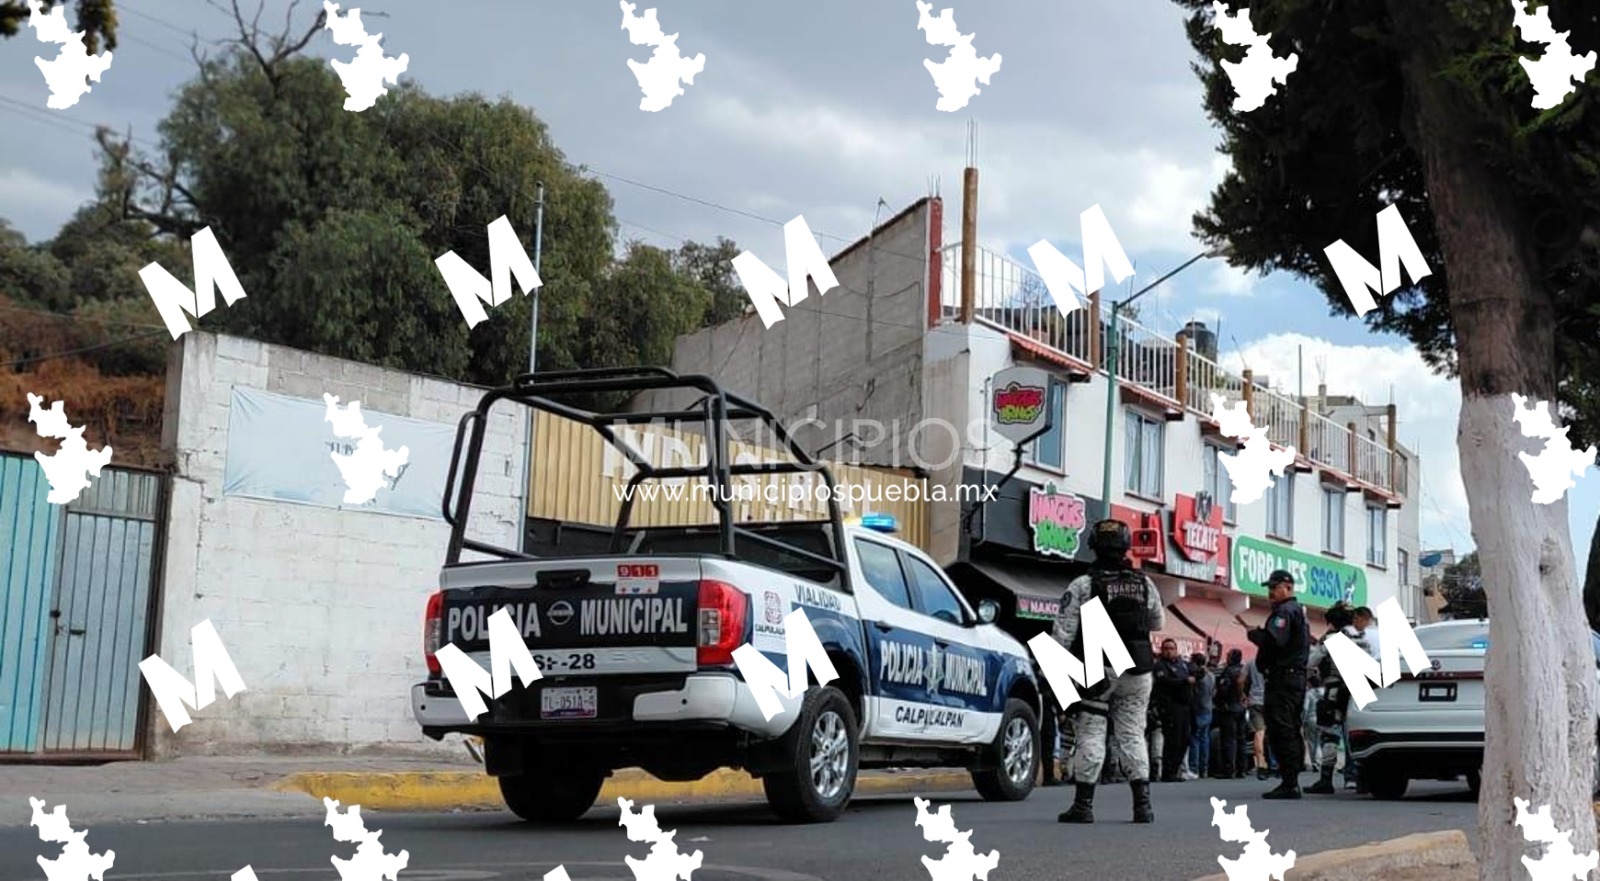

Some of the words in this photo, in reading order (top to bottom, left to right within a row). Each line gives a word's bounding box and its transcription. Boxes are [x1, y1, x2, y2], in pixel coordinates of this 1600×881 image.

[1183, 520, 1221, 554] TECATE
[618, 565, 658, 577] 911
[793, 583, 842, 611] VIALIDAD
[1106, 583, 1145, 594] GUARDIA
[580, 597, 688, 635] MUNICIPAL
[880, 639, 924, 685] POLICIA
[943, 652, 987, 697] MUNICIPAL
